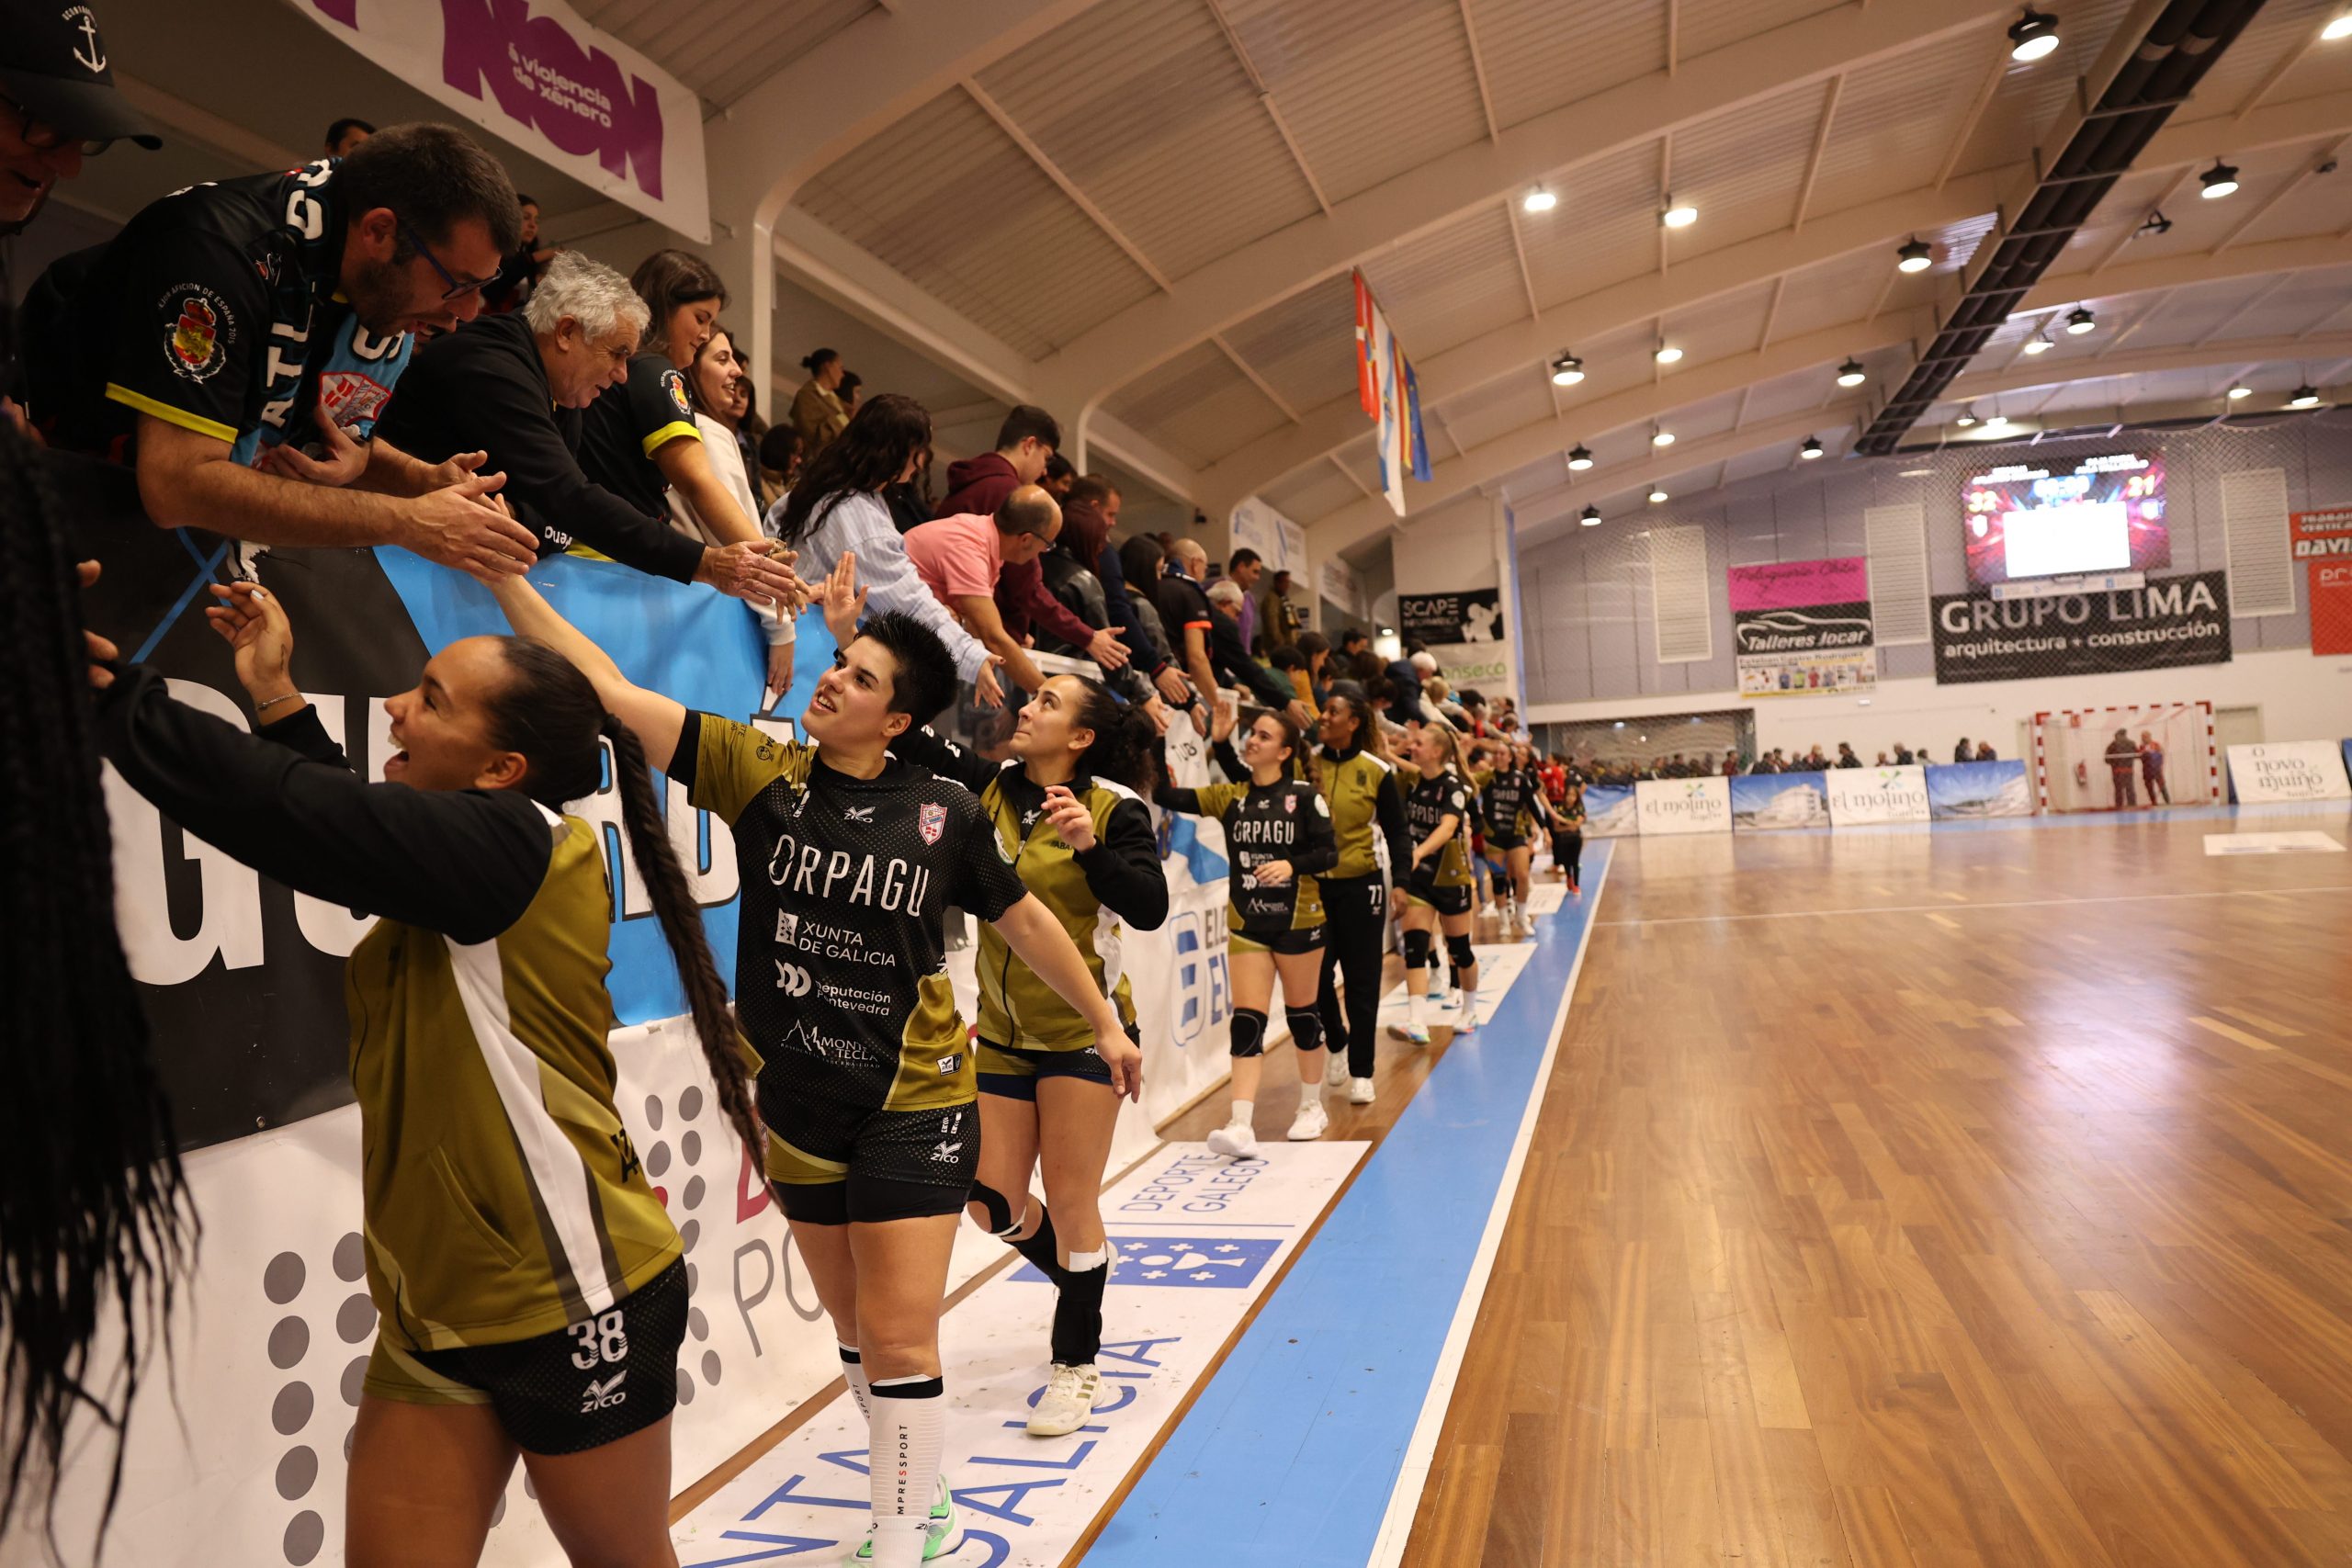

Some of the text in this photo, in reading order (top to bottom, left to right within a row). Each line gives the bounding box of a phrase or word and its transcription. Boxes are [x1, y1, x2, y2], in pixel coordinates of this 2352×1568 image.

[521, 56, 612, 112] violencia
[513, 66, 612, 129] de xénero
[202, 288, 214, 298] DE
[2127, 474, 2155, 497] 21
[1968, 491, 1997, 512] 32
[2295, 536, 2352, 557] DAVI
[1940, 581, 2220, 633] GRUPO LIMA
[1747, 634, 1816, 651] Talleres
[1945, 635, 2067, 660] arquitectura
[2087, 619, 2221, 648] construcción
[2255, 758, 2305, 775] novo
[1664, 793, 1723, 817] molino
[1853, 787, 1927, 811] molino
[1233, 820, 1295, 844] ORPAGU
[768, 833, 930, 918] ORPAGU
[803, 921, 864, 946] XUNTA
[798, 937, 896, 967] DE GALICIA
[817, 990, 890, 1016] Pntevedra
[1118, 1154, 1223, 1212] DEPORTE
[1182, 1158, 1270, 1213] GALEGO
[567, 1309, 628, 1370] 38
